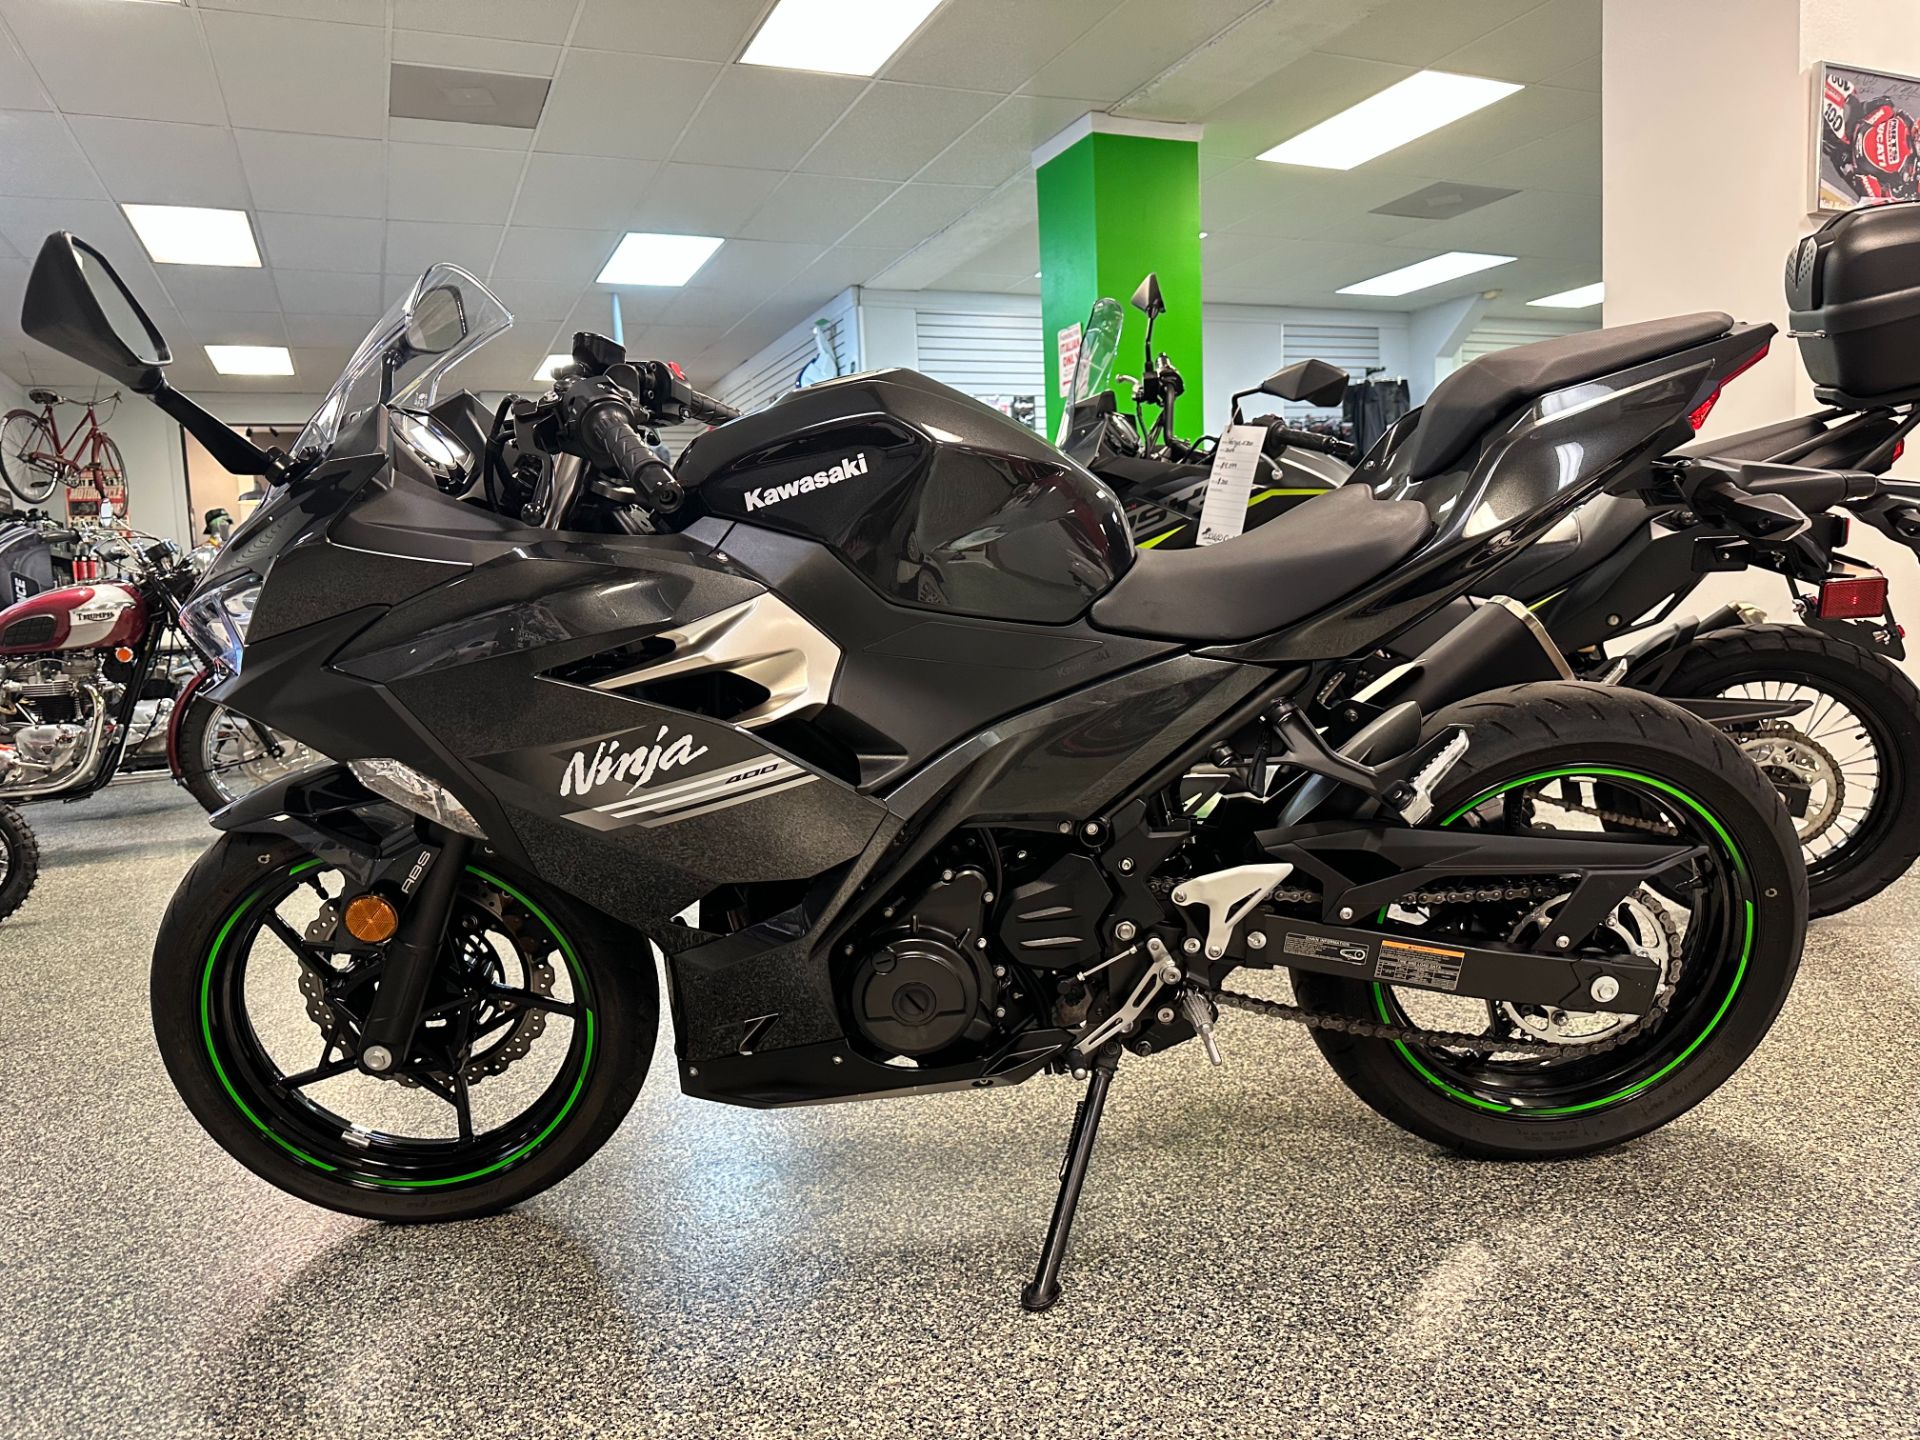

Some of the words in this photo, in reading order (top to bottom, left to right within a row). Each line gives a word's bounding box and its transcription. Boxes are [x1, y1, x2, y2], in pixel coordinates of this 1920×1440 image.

[1824, 103, 1843, 132] 100
[744, 453, 868, 512] Kawasaki
[76, 611, 115, 621] TRIUMPH
[560, 725, 708, 796] Ninja
[725, 763, 779, 784] 400
[401, 850, 430, 894] ABS
